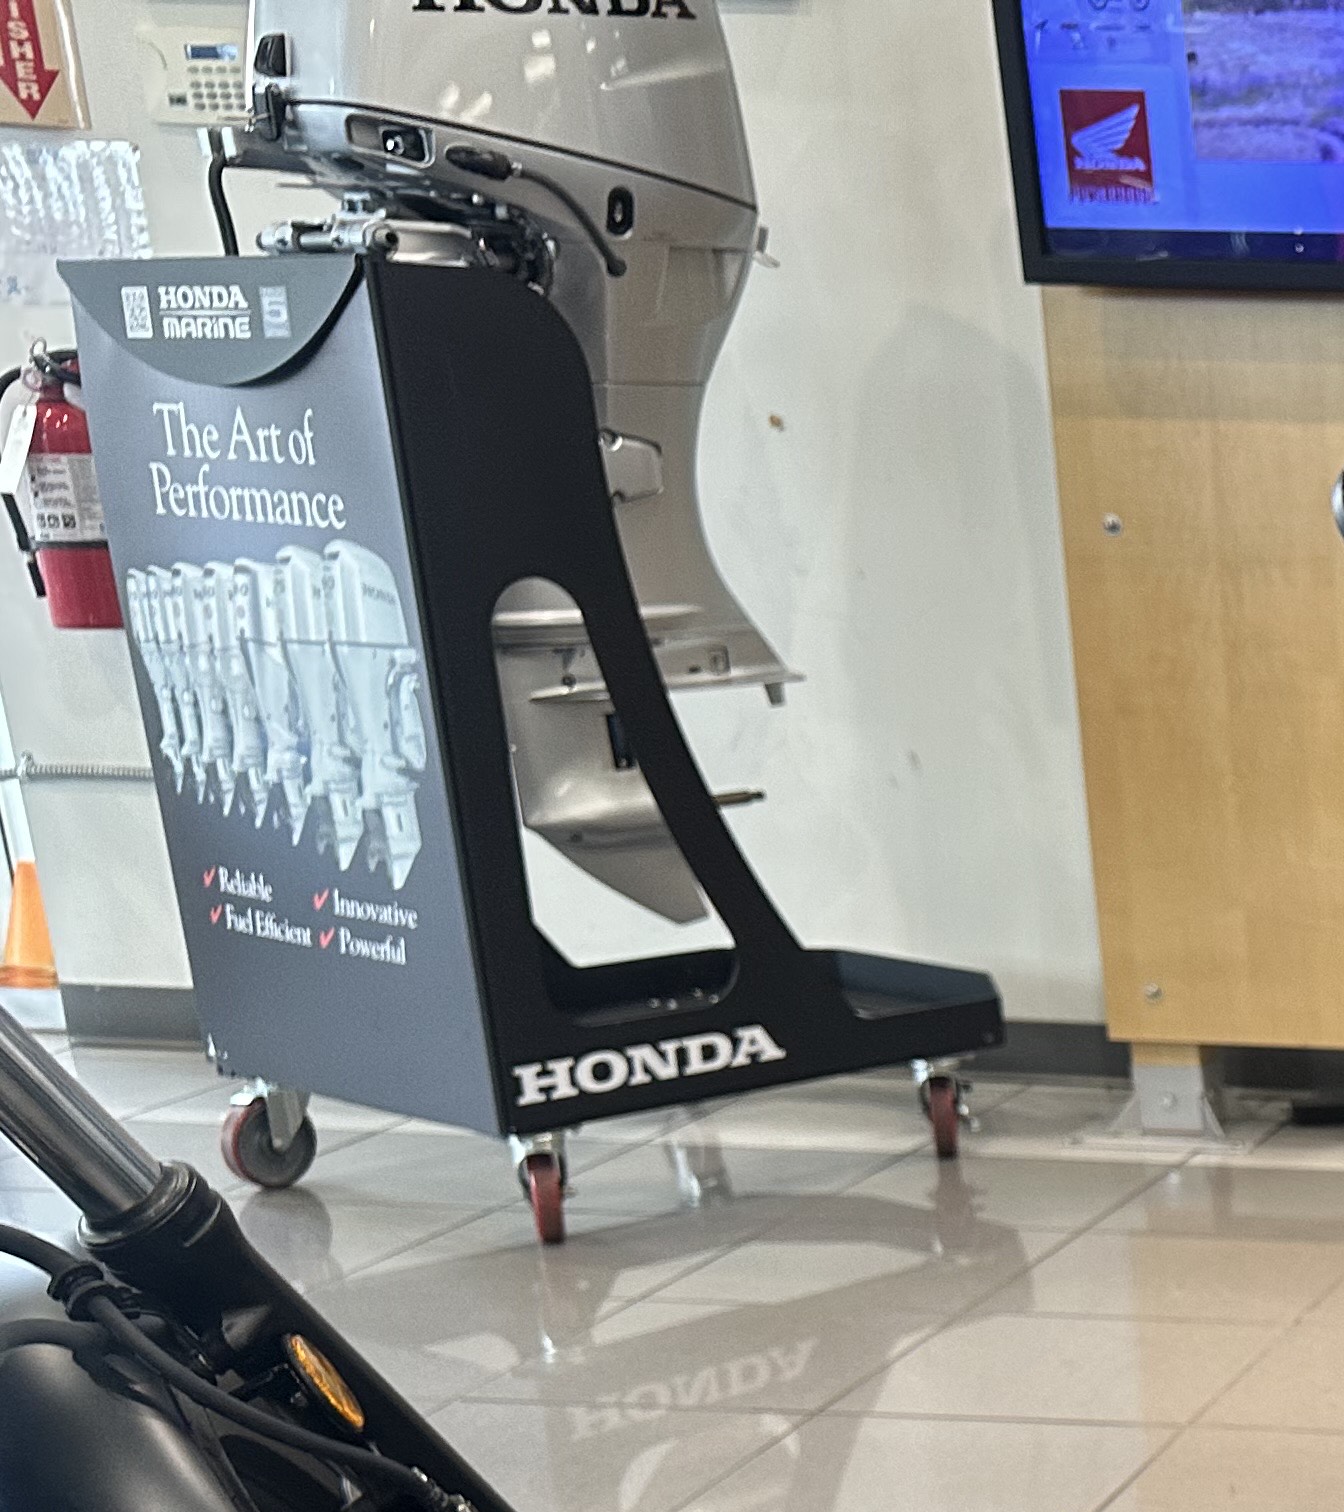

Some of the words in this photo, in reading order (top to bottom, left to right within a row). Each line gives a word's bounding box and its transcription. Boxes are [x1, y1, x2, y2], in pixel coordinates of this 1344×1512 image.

[157, 285, 249, 309] HONDA
[152, 401, 221, 459] The
[227, 404, 285, 464] Art
[288, 408, 316, 465] of
[149, 461, 346, 530] Performance
[218, 865, 273, 903] Reliable
[225, 902, 254, 935] Fuel
[255, 909, 312, 948] Efficient
[333, 888, 418, 930] Innovative
[339, 926, 407, 966] Powerful
[512, 1023, 787, 1107] HONDA
